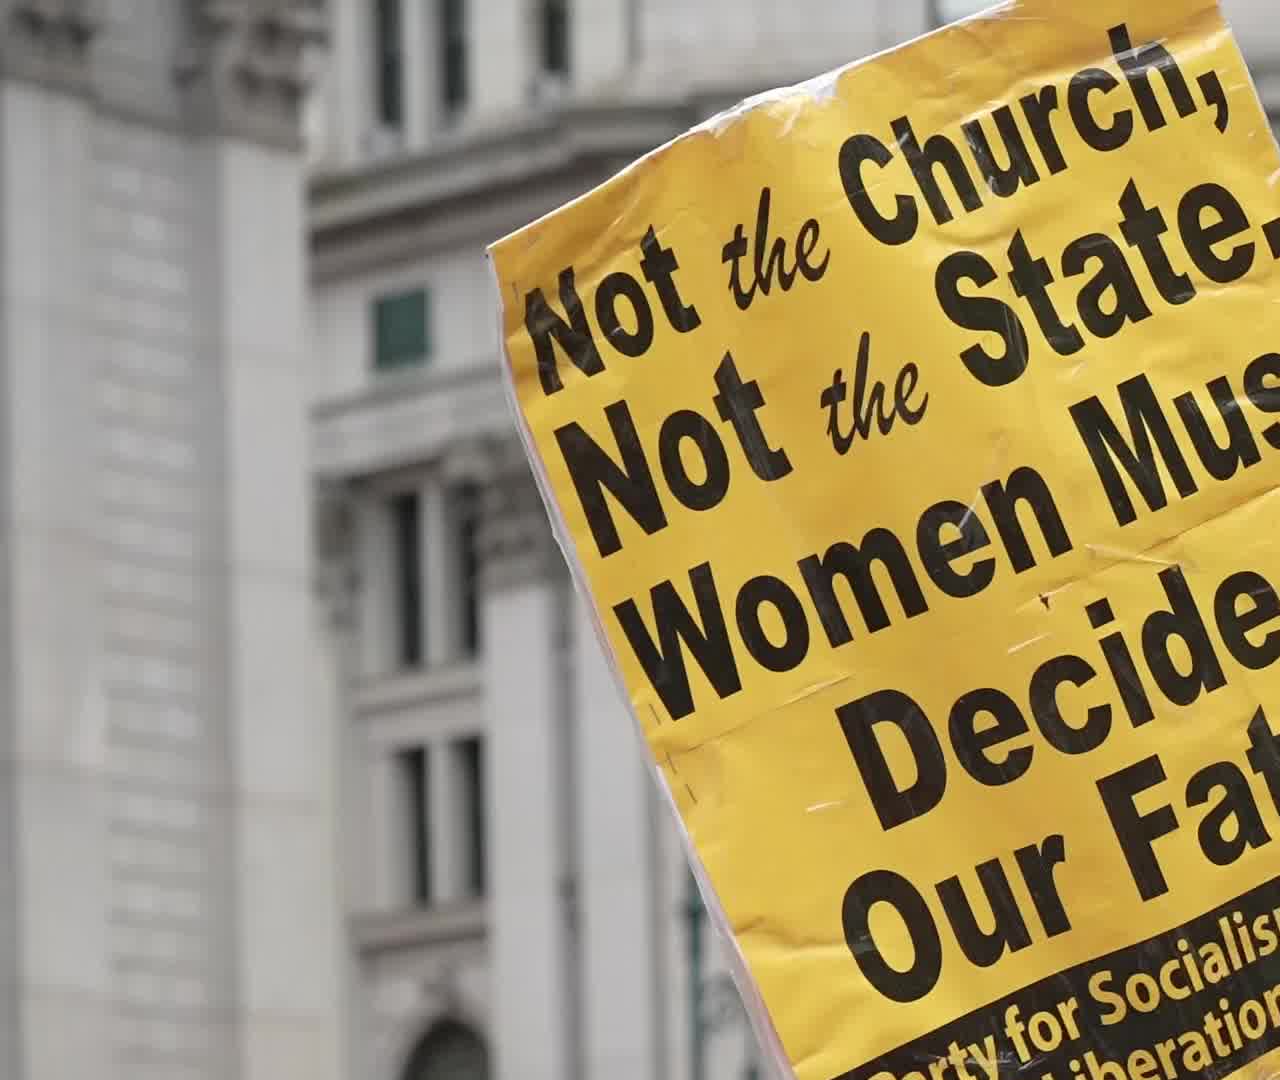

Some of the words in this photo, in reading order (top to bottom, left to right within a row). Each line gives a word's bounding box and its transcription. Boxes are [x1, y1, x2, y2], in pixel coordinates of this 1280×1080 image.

[523, 225, 702, 396] Not
[721, 186, 831, 313] the
[839, 23, 1230, 247] Church,
[553, 350, 798, 557] Not
[820, 331, 928, 457] the
[614, 463, 1071, 721] Women
[842, 832, 1072, 1002] Our
[1005, 996, 1081, 1062] for
